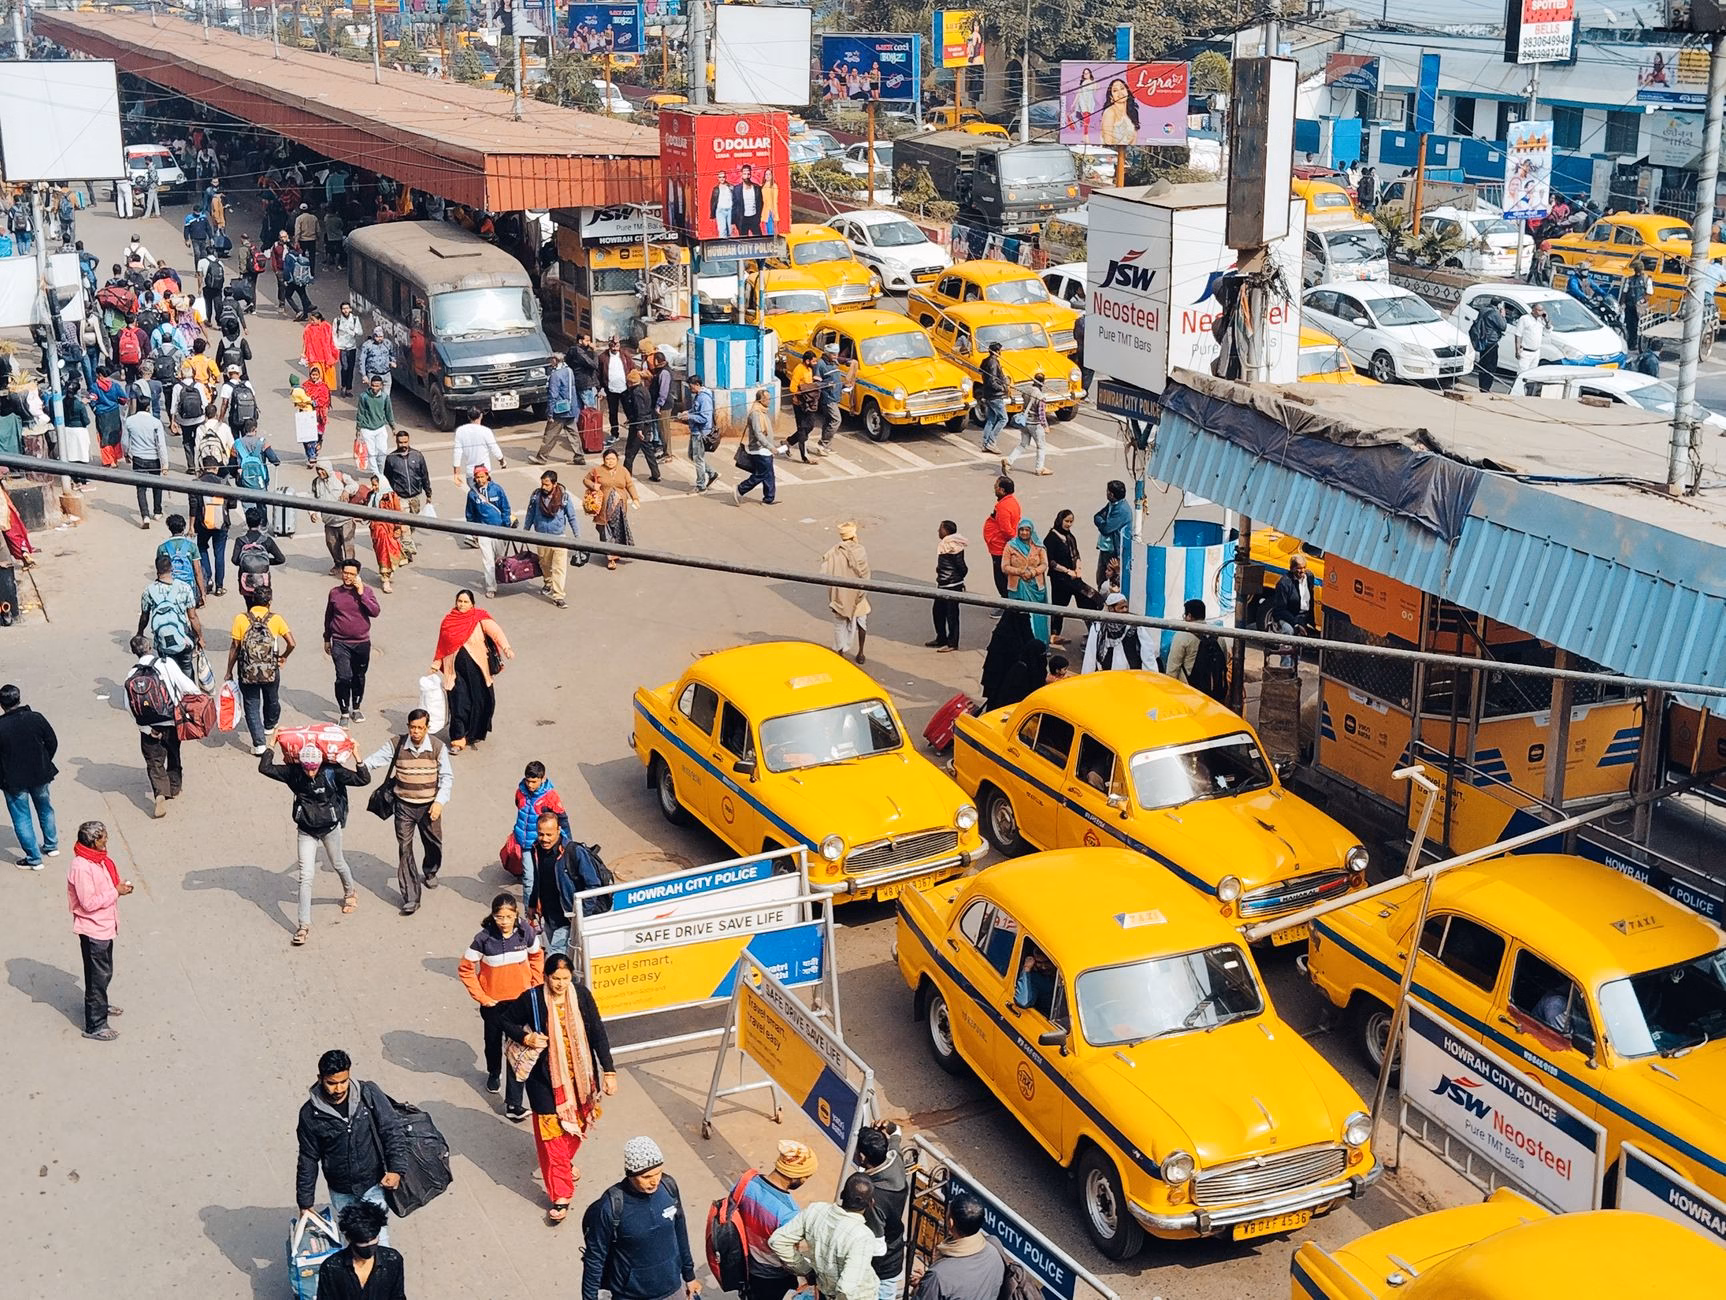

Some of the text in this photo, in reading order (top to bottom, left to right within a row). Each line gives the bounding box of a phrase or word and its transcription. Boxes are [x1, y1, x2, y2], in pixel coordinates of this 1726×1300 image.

[1532, 0, 1568, 10] SPOTTED
[1535, 24, 1560, 35] BELLS
[1136, 70, 1176, 96] Lyra
[726, 137, 771, 151] DOLLAR
[585, 207, 636, 226] JSW
[599, 235, 633, 245] HOWRAH
[634, 233, 653, 242] CIY
[737, 243, 753, 255] CITY
[1098, 259, 1156, 291] JSW
[1093, 291, 1160, 332] Neosteel
[1098, 325, 1151, 353] Pure TMT Bars
[1191, 342, 1219, 357] Pure
[1124, 393, 1139, 412] CITY
[1605, 856, 1649, 885] HOWRAH
[627, 866, 758, 904] HOWRAH CITY POLICE
[1676, 888, 1714, 915] POLICE
[635, 910, 784, 944] SAFE DRIVE SAVE LIFE
[1628, 916, 1656, 930] TAXI
[591, 955, 673, 975] Travel smart,
[592, 971, 661, 990] travel easy
[747, 994, 766, 1019] Travel
[747, 1011, 766, 1034] travel
[766, 1029, 780, 1051] easy
[765, 984, 841, 1067] SAFE DRIVE SAVE LIFE
[1444, 1036, 1490, 1077] HOWRAH
[1491, 1069, 1516, 1095] CITY
[1516, 1086, 1558, 1123] POLICE
[1429, 1074, 1572, 1181] JSW Neosteel
[1465, 1119, 1525, 1169] Pure TMT Bars
[951, 1181, 996, 1229] HAH
[997, 1220, 1023, 1249] CITY
[1023, 1241, 1065, 1285] POLICE
